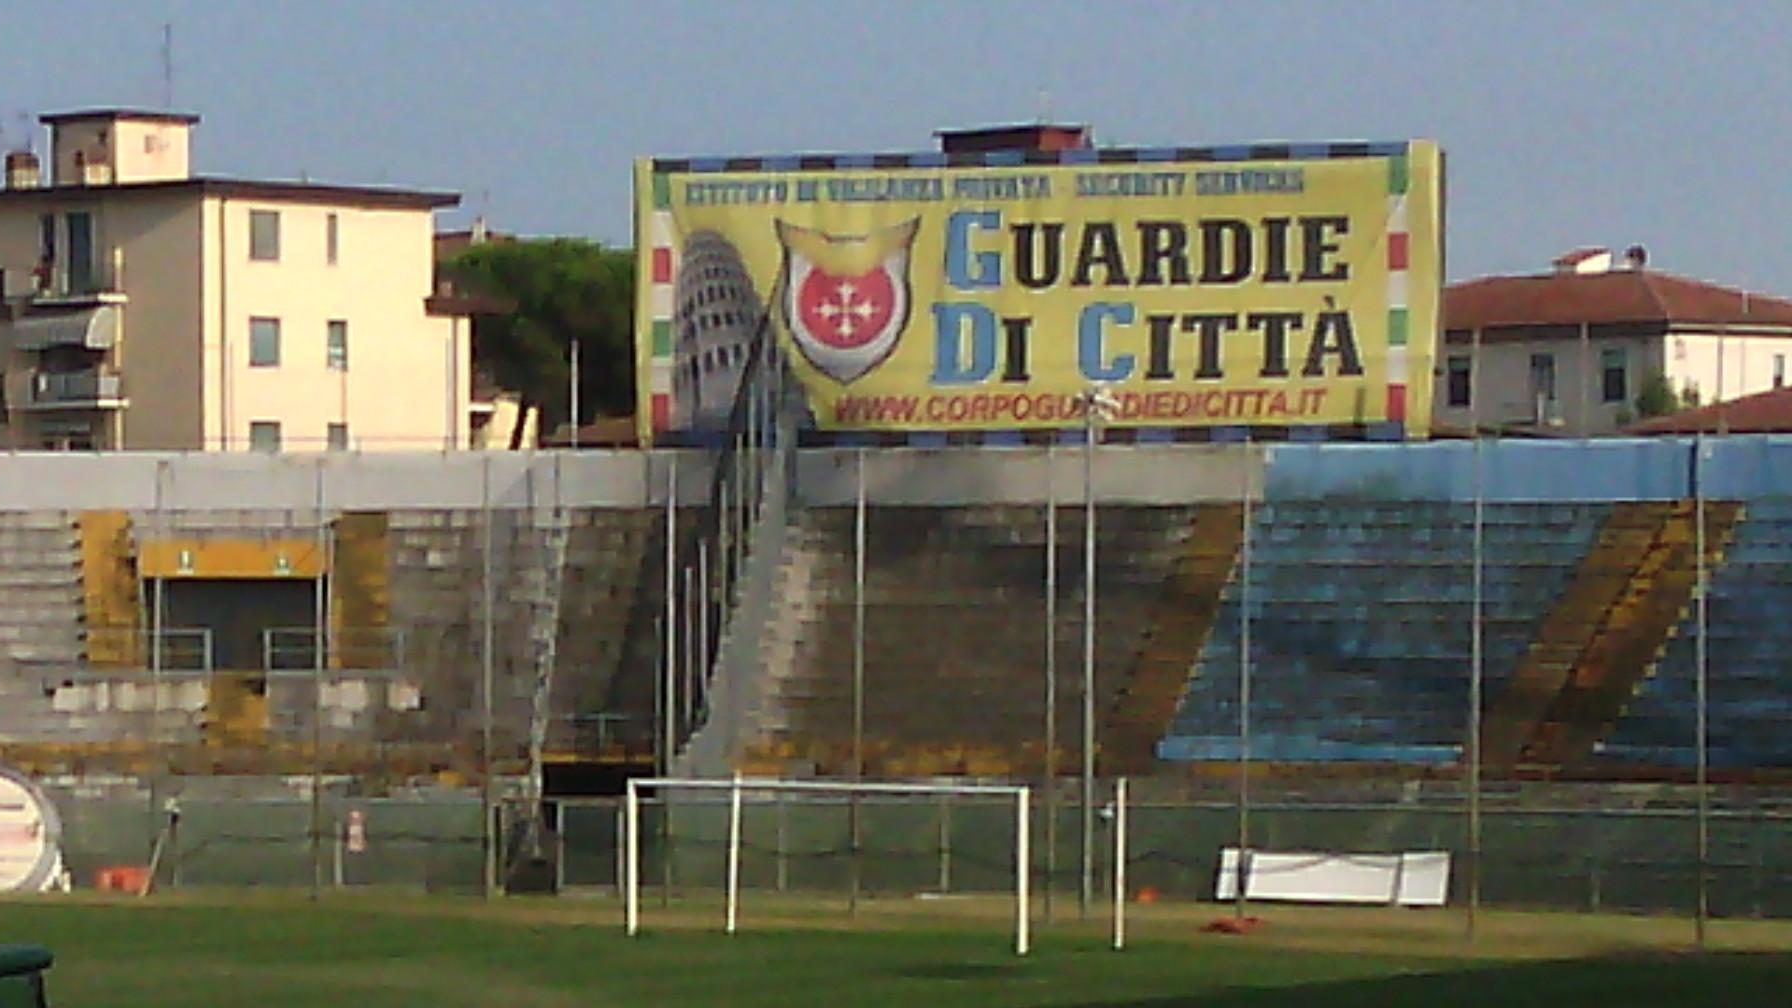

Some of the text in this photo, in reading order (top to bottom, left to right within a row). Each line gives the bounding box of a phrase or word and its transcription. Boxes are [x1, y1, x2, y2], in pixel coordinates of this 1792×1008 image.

[943, 209, 1350, 290] GUARDIE
[929, 295, 1364, 385] DI CITTÀ
[834, 388, 1327, 424] WWW.CORPOGUDIEDICITTA.IT
